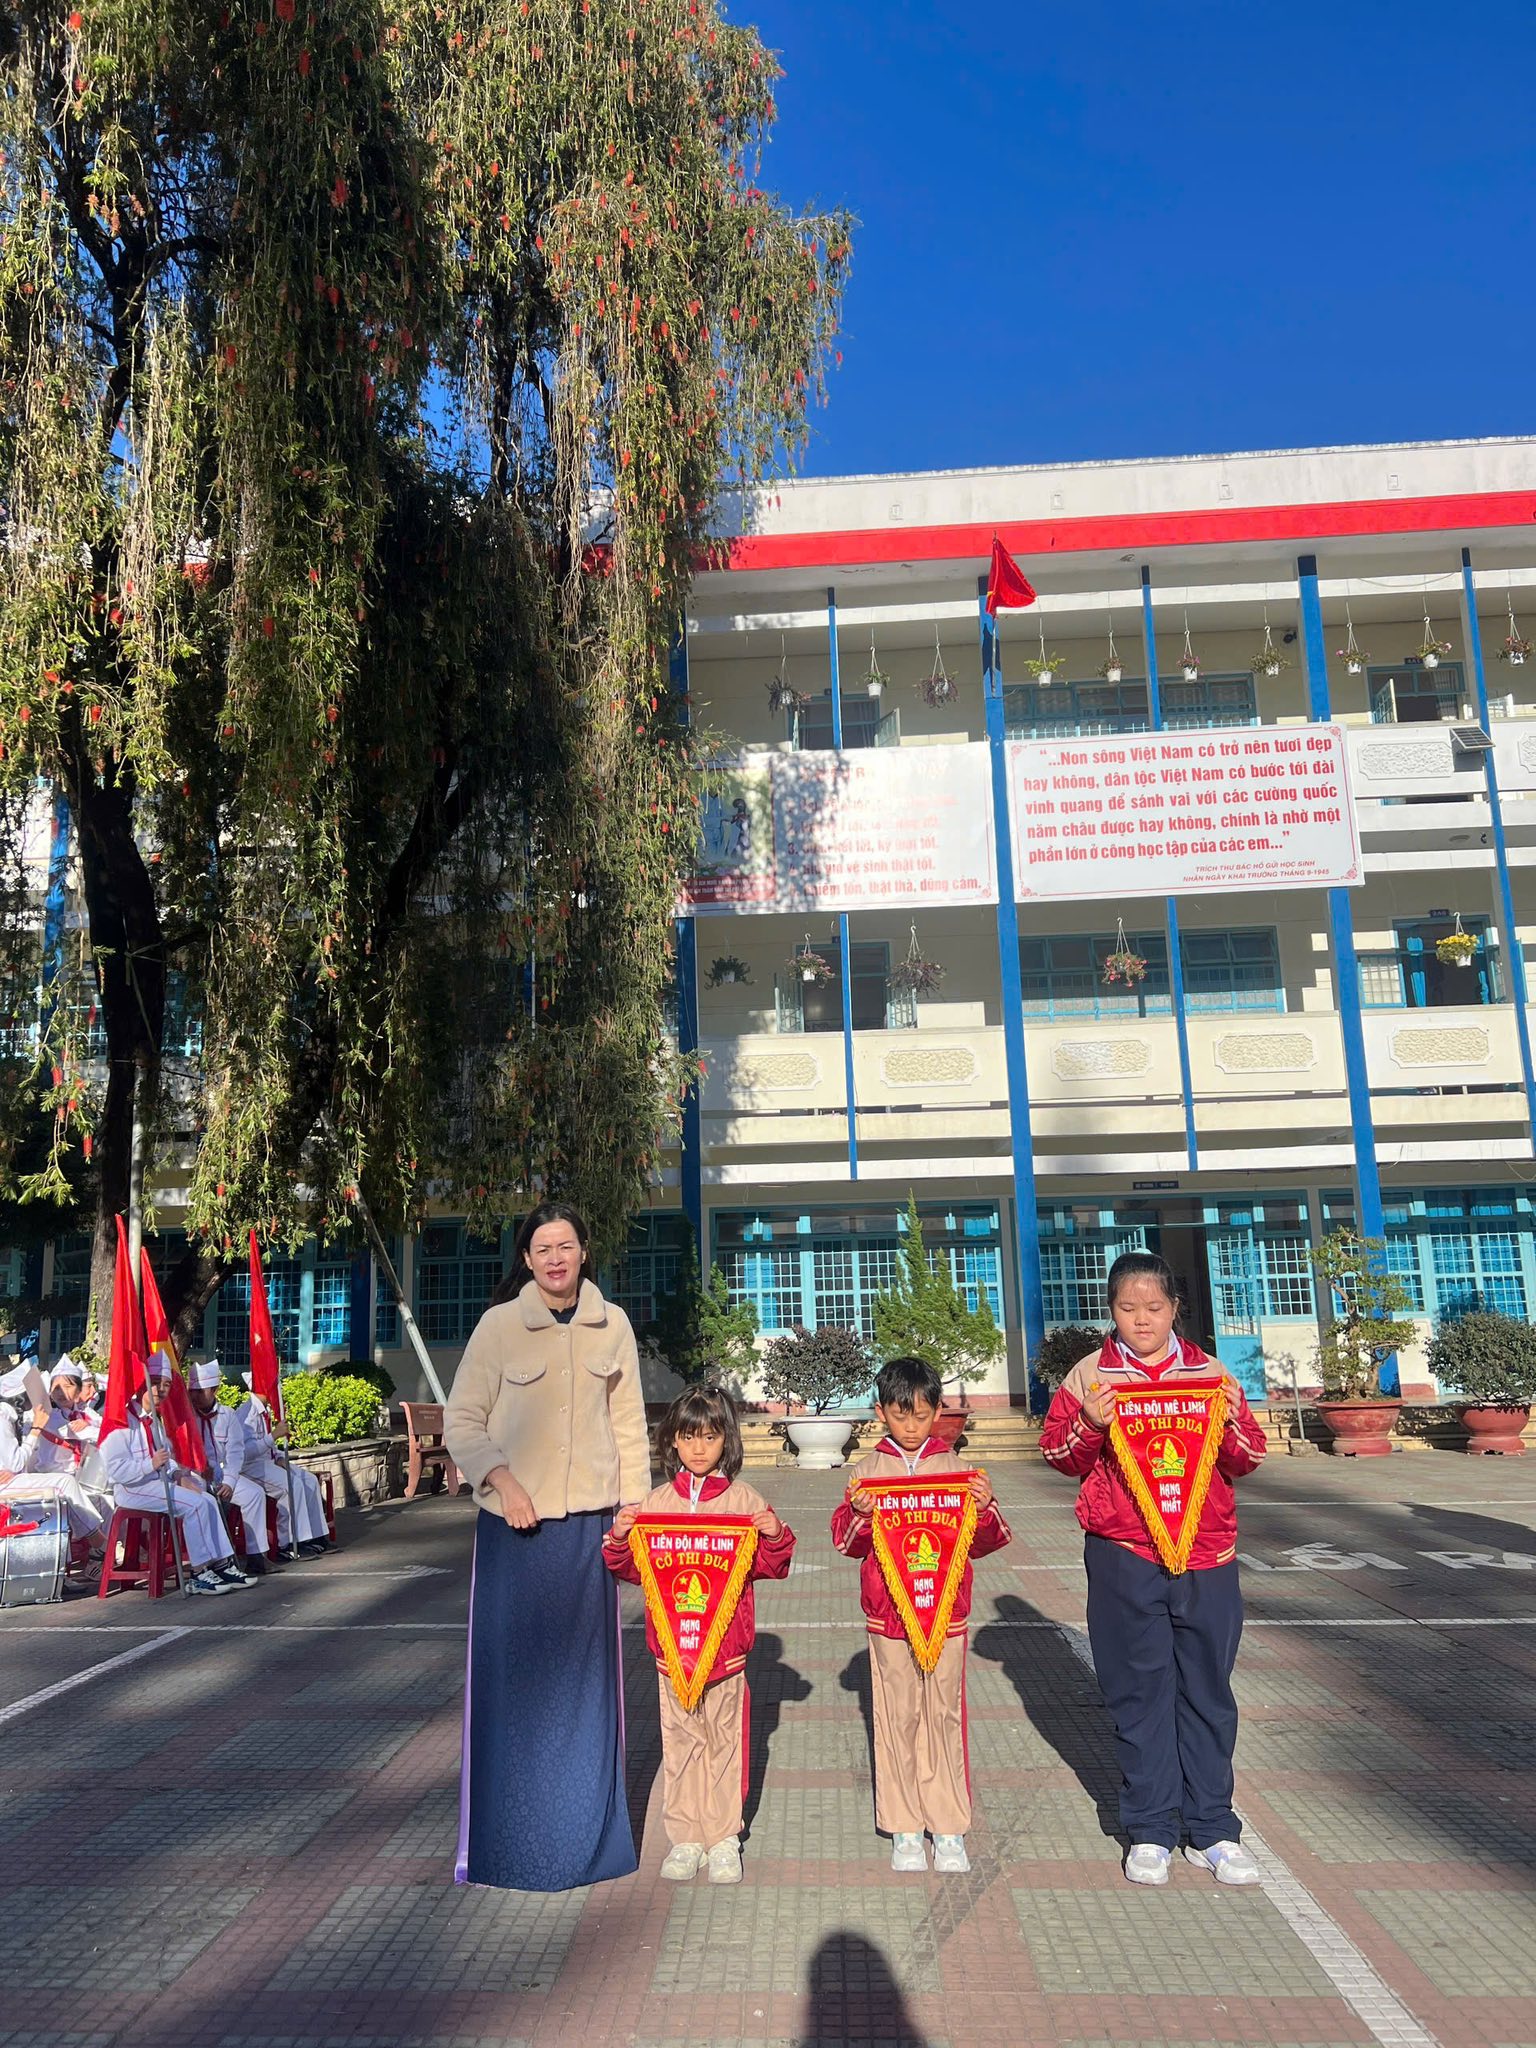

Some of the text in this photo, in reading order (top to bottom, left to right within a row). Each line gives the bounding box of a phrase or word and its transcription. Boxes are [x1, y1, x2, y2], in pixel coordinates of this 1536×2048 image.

[1093, 750, 1126, 764] sông
[1131, 748, 1157, 763] Việt
[1161, 745, 1193, 759] Nam
[1199, 743, 1215, 757] có
[1220, 740, 1239, 755] trở
[1244, 740, 1270, 754] nên
[1275, 738, 1301, 753] tươi
[1307, 737, 1332, 754] đẹp
[1024, 759, 1335, 792] hay không, dân tộc Việt Nam có bước tới đài
[1026, 781, 1338, 815] vinh quang để sánh vai với các cường quốc
[1027, 807, 1342, 839] năm châu được hay không, chính là nhờ một
[1029, 845, 1063, 864] phần
[1066, 845, 1087, 860] lớn
[1090, 844, 1101, 859] ở
[1101, 844, 1135, 859] công
[1138, 843, 1164, 859] học
[1166, 840, 1188, 859] tập
[1191, 837, 1216, 853] của
[1219, 836, 1245, 851] các
[1228, 872, 1245, 880] KHAI
[1119, 1400, 1206, 1417] LIÊN ĐỘI MÊ LINH
[1127, 1417, 1203, 1436] CỜ THI ĐUA
[1159, 1482, 1181, 1498] HẠNG
[878, 1493, 960, 1511] LIÊN ĐỘI MÊ LINH
[1161, 1497, 1182, 1513] NHẤT
[884, 1511, 958, 1530] CỜ THI ĐUA
[651, 1534, 734, 1552] LIÊN ĐỘI MÊ LINH
[655, 1552, 729, 1572] CỜ THI ĐUA
[914, 1577, 934, 1592] HẠNG
[915, 1592, 935, 1607] NHẤT
[680, 1619, 700, 1634] HẠNG
[680, 1634, 699, 1649] NHẤT
